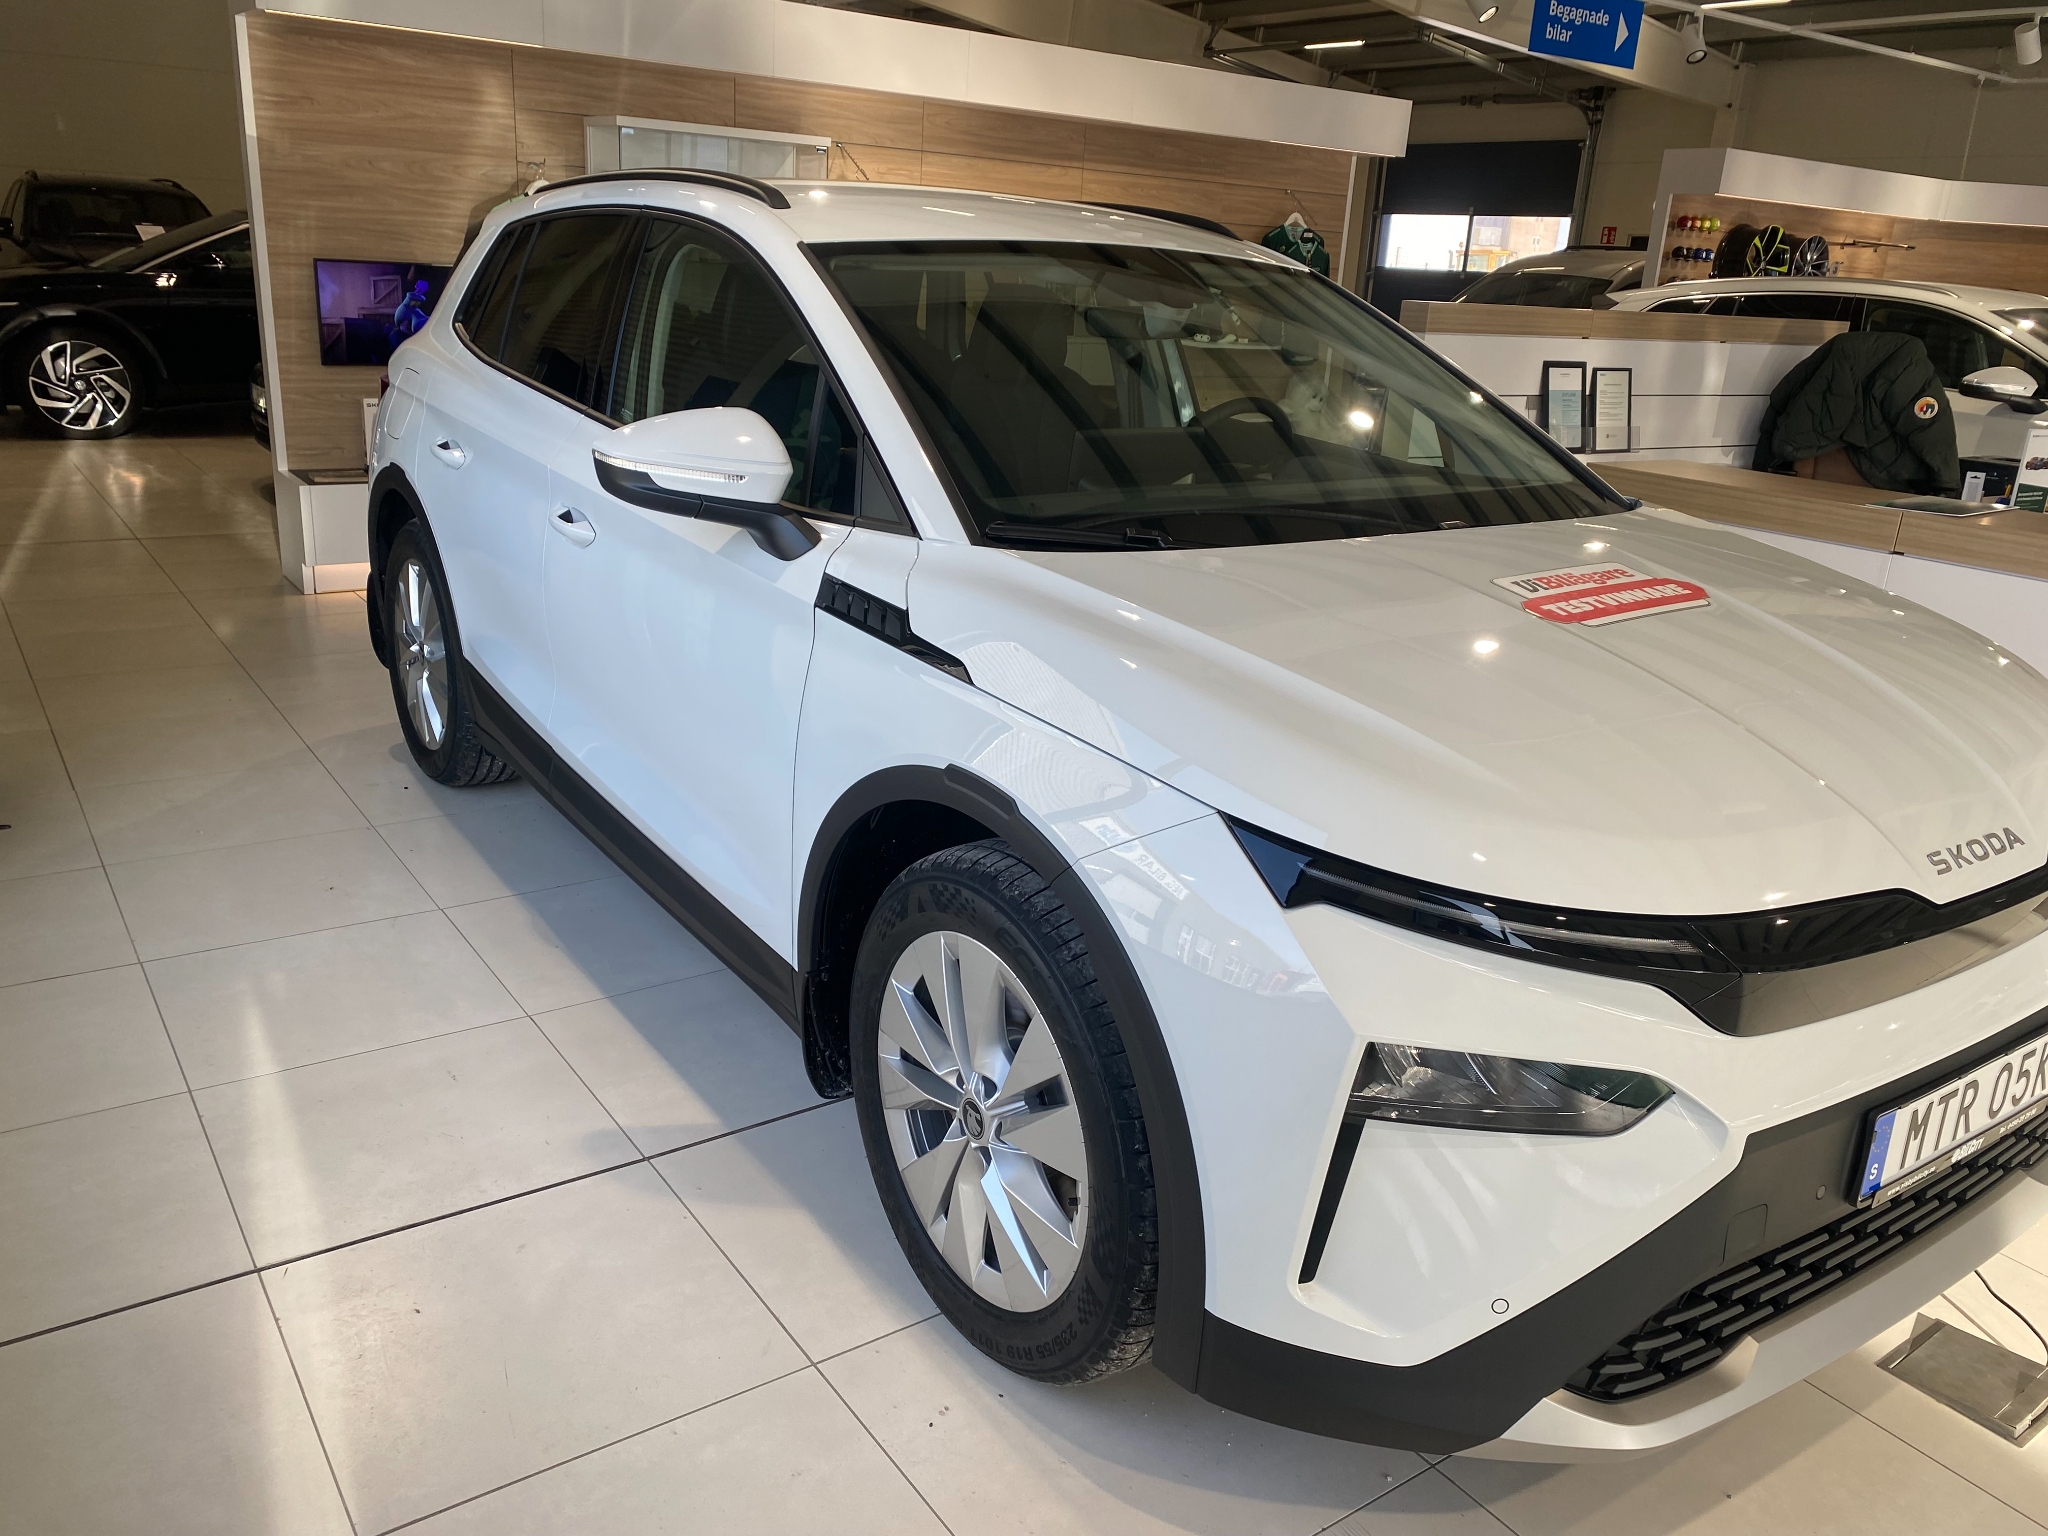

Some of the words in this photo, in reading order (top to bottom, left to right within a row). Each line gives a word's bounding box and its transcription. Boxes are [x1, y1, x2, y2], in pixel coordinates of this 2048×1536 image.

[1549, 0, 1610, 27] Begagnade
[1546, 23, 1573, 43] bilar
[1540, 583, 1693, 616] TESTVINNARE
[1926, 827, 2026, 876] SKODA
[1868, 1162, 1879, 1181] S
[1899, 1079, 1980, 1171] MTR
[1006, 1345, 1035, 1362] R19
[1035, 1321, 1078, 1360] 235/55
